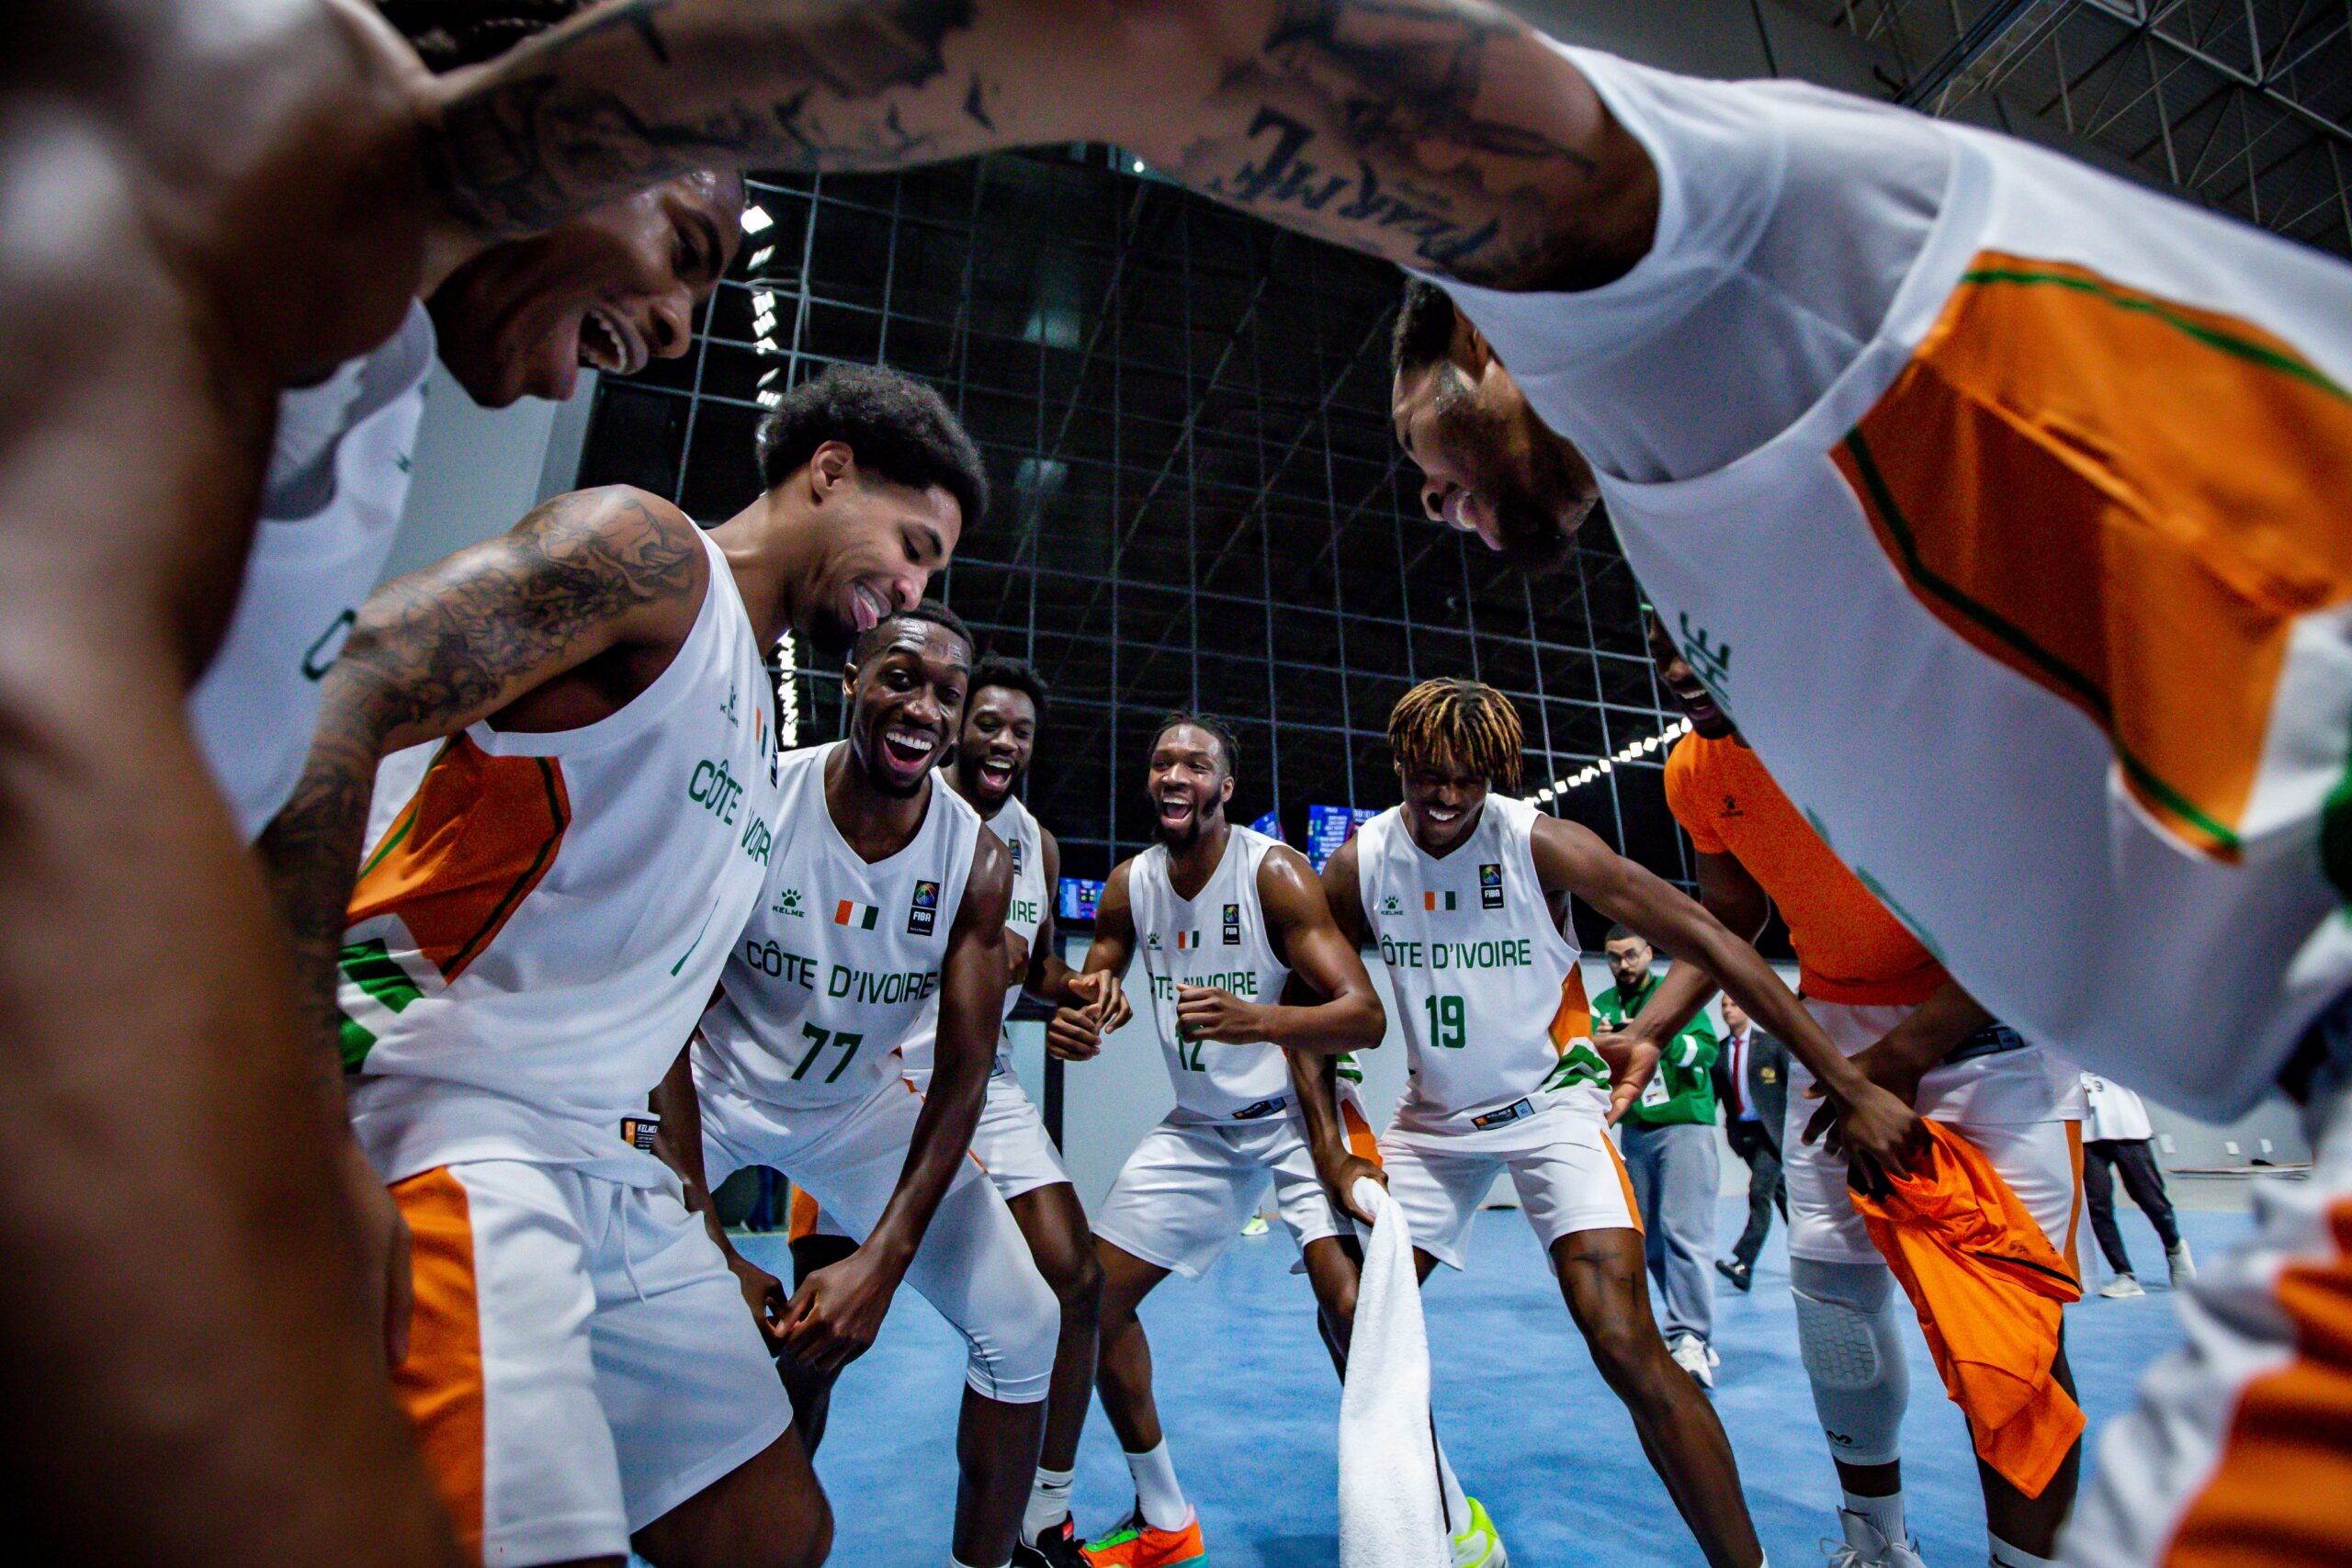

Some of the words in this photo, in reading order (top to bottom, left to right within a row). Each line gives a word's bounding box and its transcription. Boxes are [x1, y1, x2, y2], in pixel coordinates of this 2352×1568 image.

[688, 759, 743, 826] CÔTE
[1484, 888, 1500, 898] FIBA
[772, 905, 805, 918] KELME
[912, 910, 932, 922] FIBA
[1006, 899, 1037, 924] IRE
[1431, 939, 1532, 969] D'IVOIRE
[746, 940, 818, 990] CÔTE
[828, 964, 937, 1004] D'IVOIRE
[1151, 973, 1173, 1000] TE
[1426, 995, 1466, 1049] 19
[791, 1021, 864, 1084] 77
